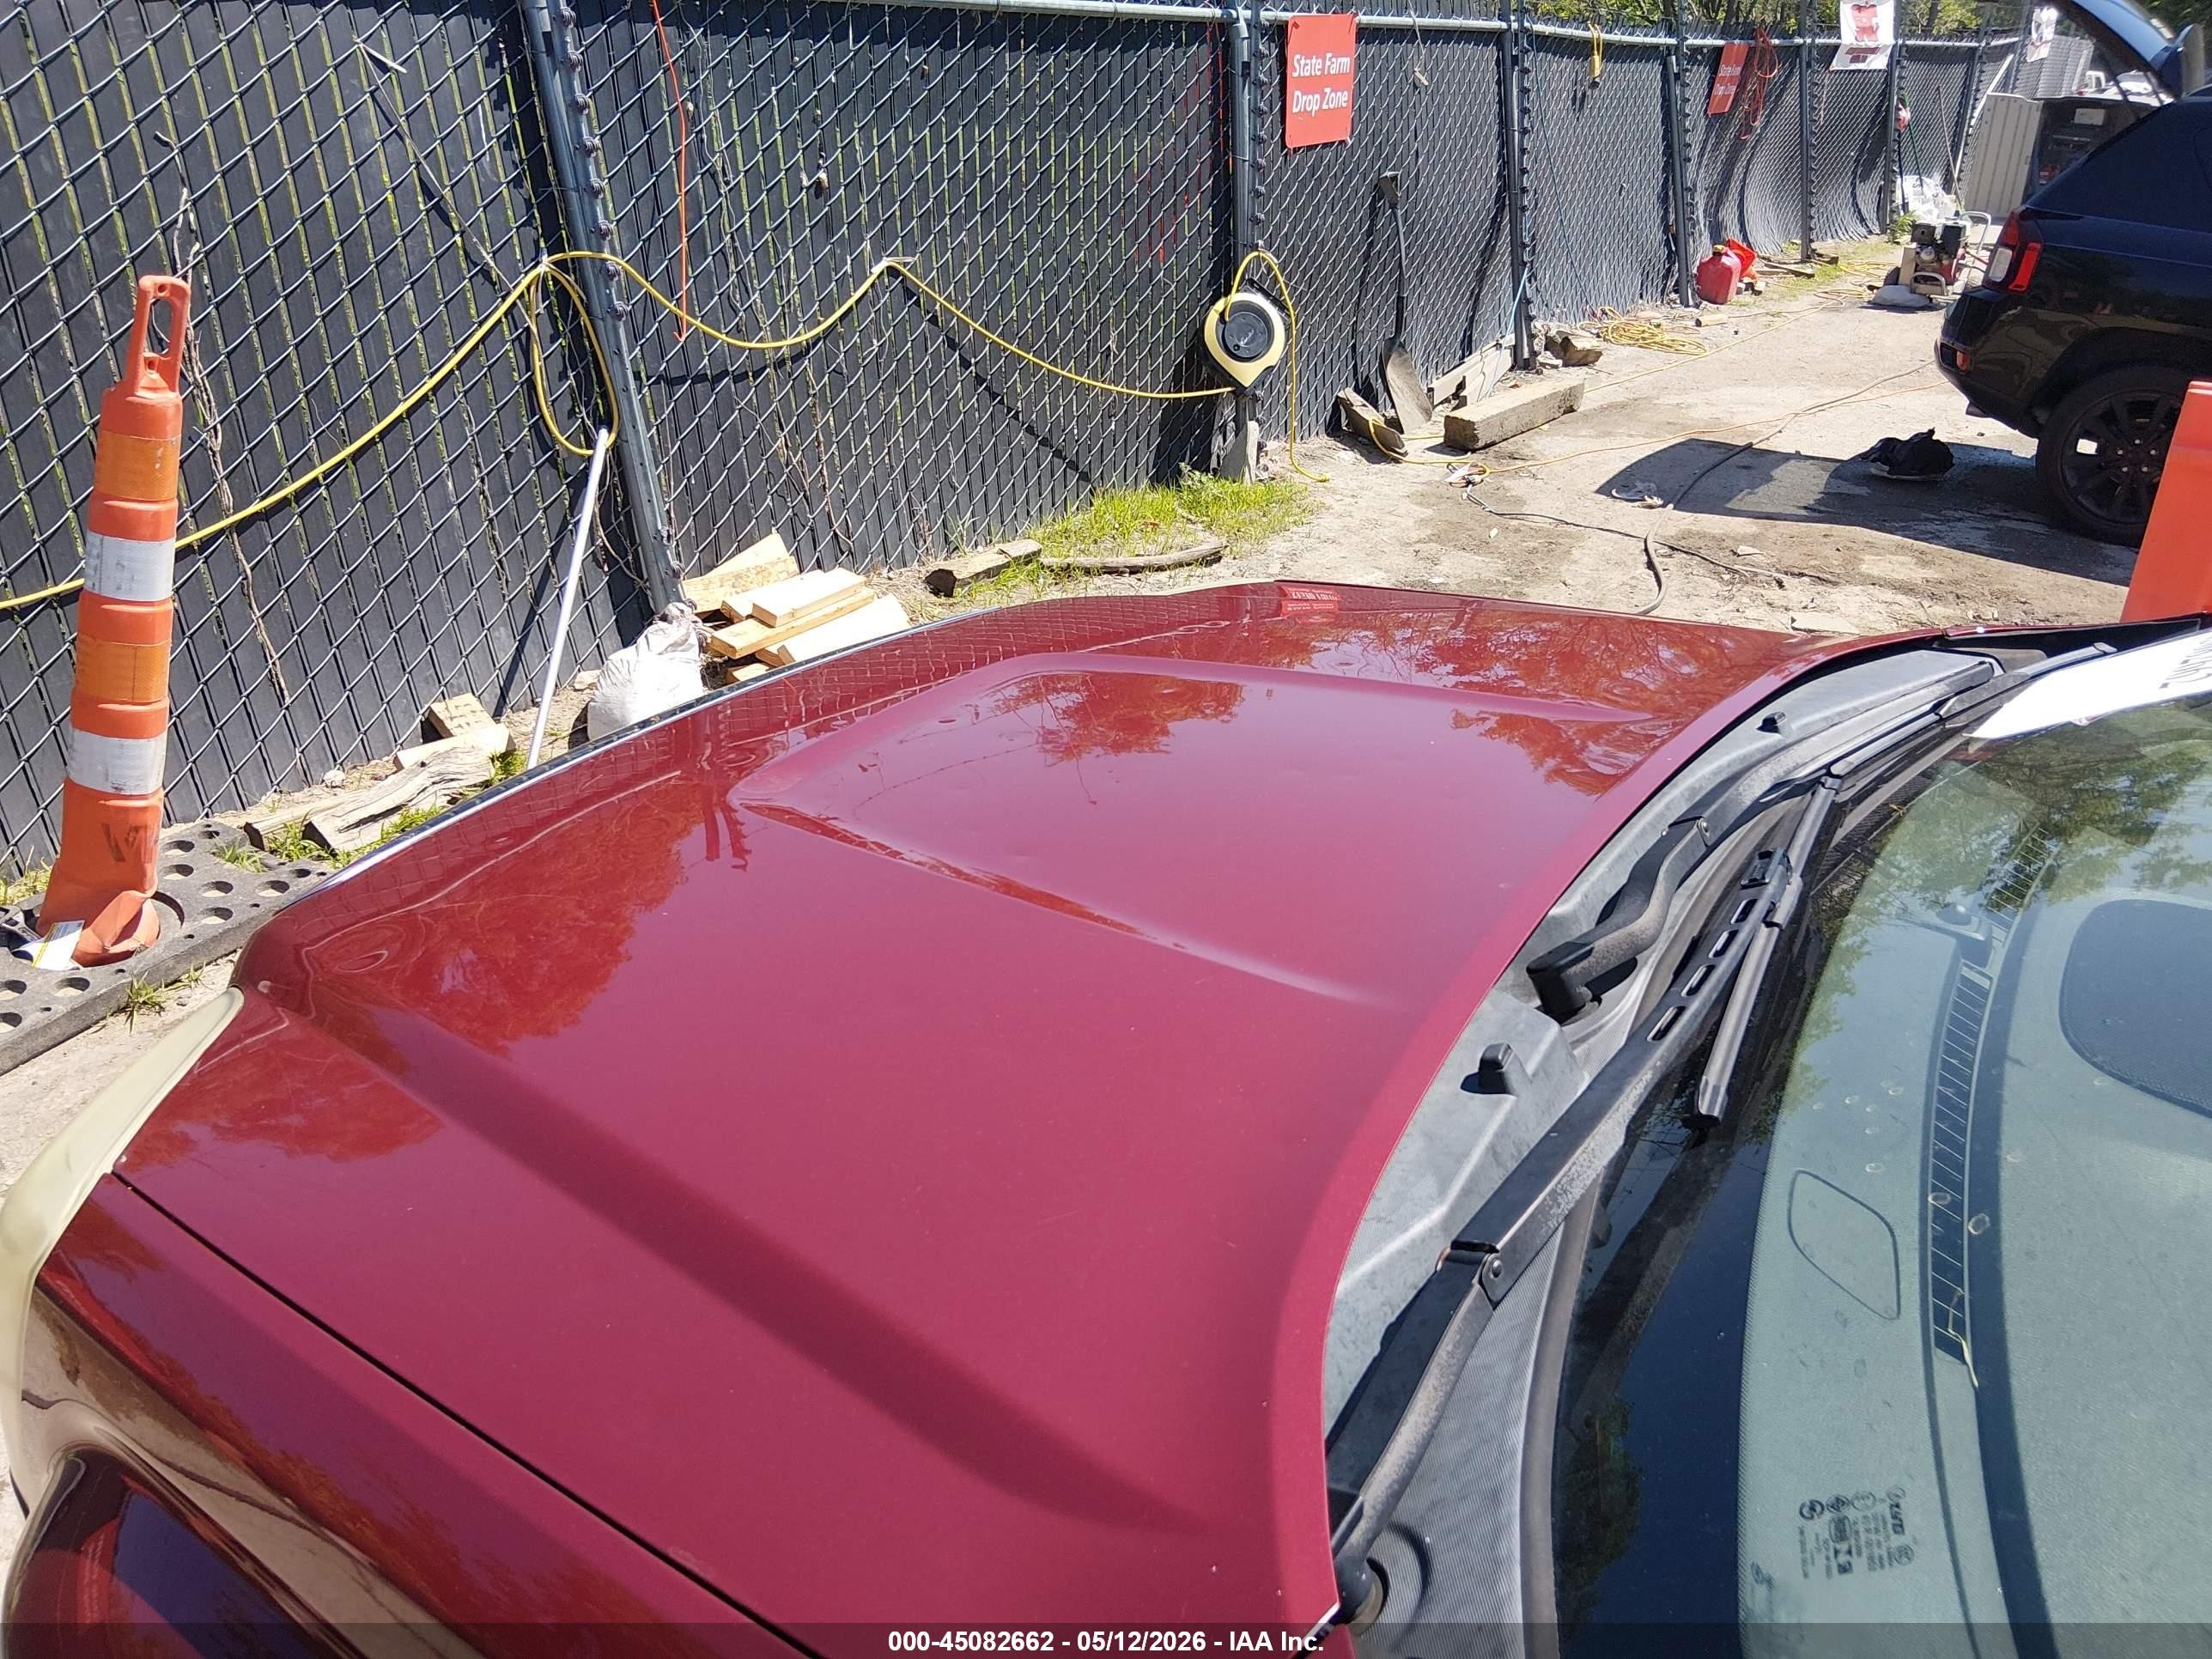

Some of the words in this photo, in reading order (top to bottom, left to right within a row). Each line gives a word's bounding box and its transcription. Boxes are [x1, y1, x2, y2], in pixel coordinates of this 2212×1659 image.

[1291, 54, 1322, 77] State
[1324, 52, 1351, 76] Farm
[1291, 90, 1321, 117] Drop
[1322, 87, 1348, 110] Zone
